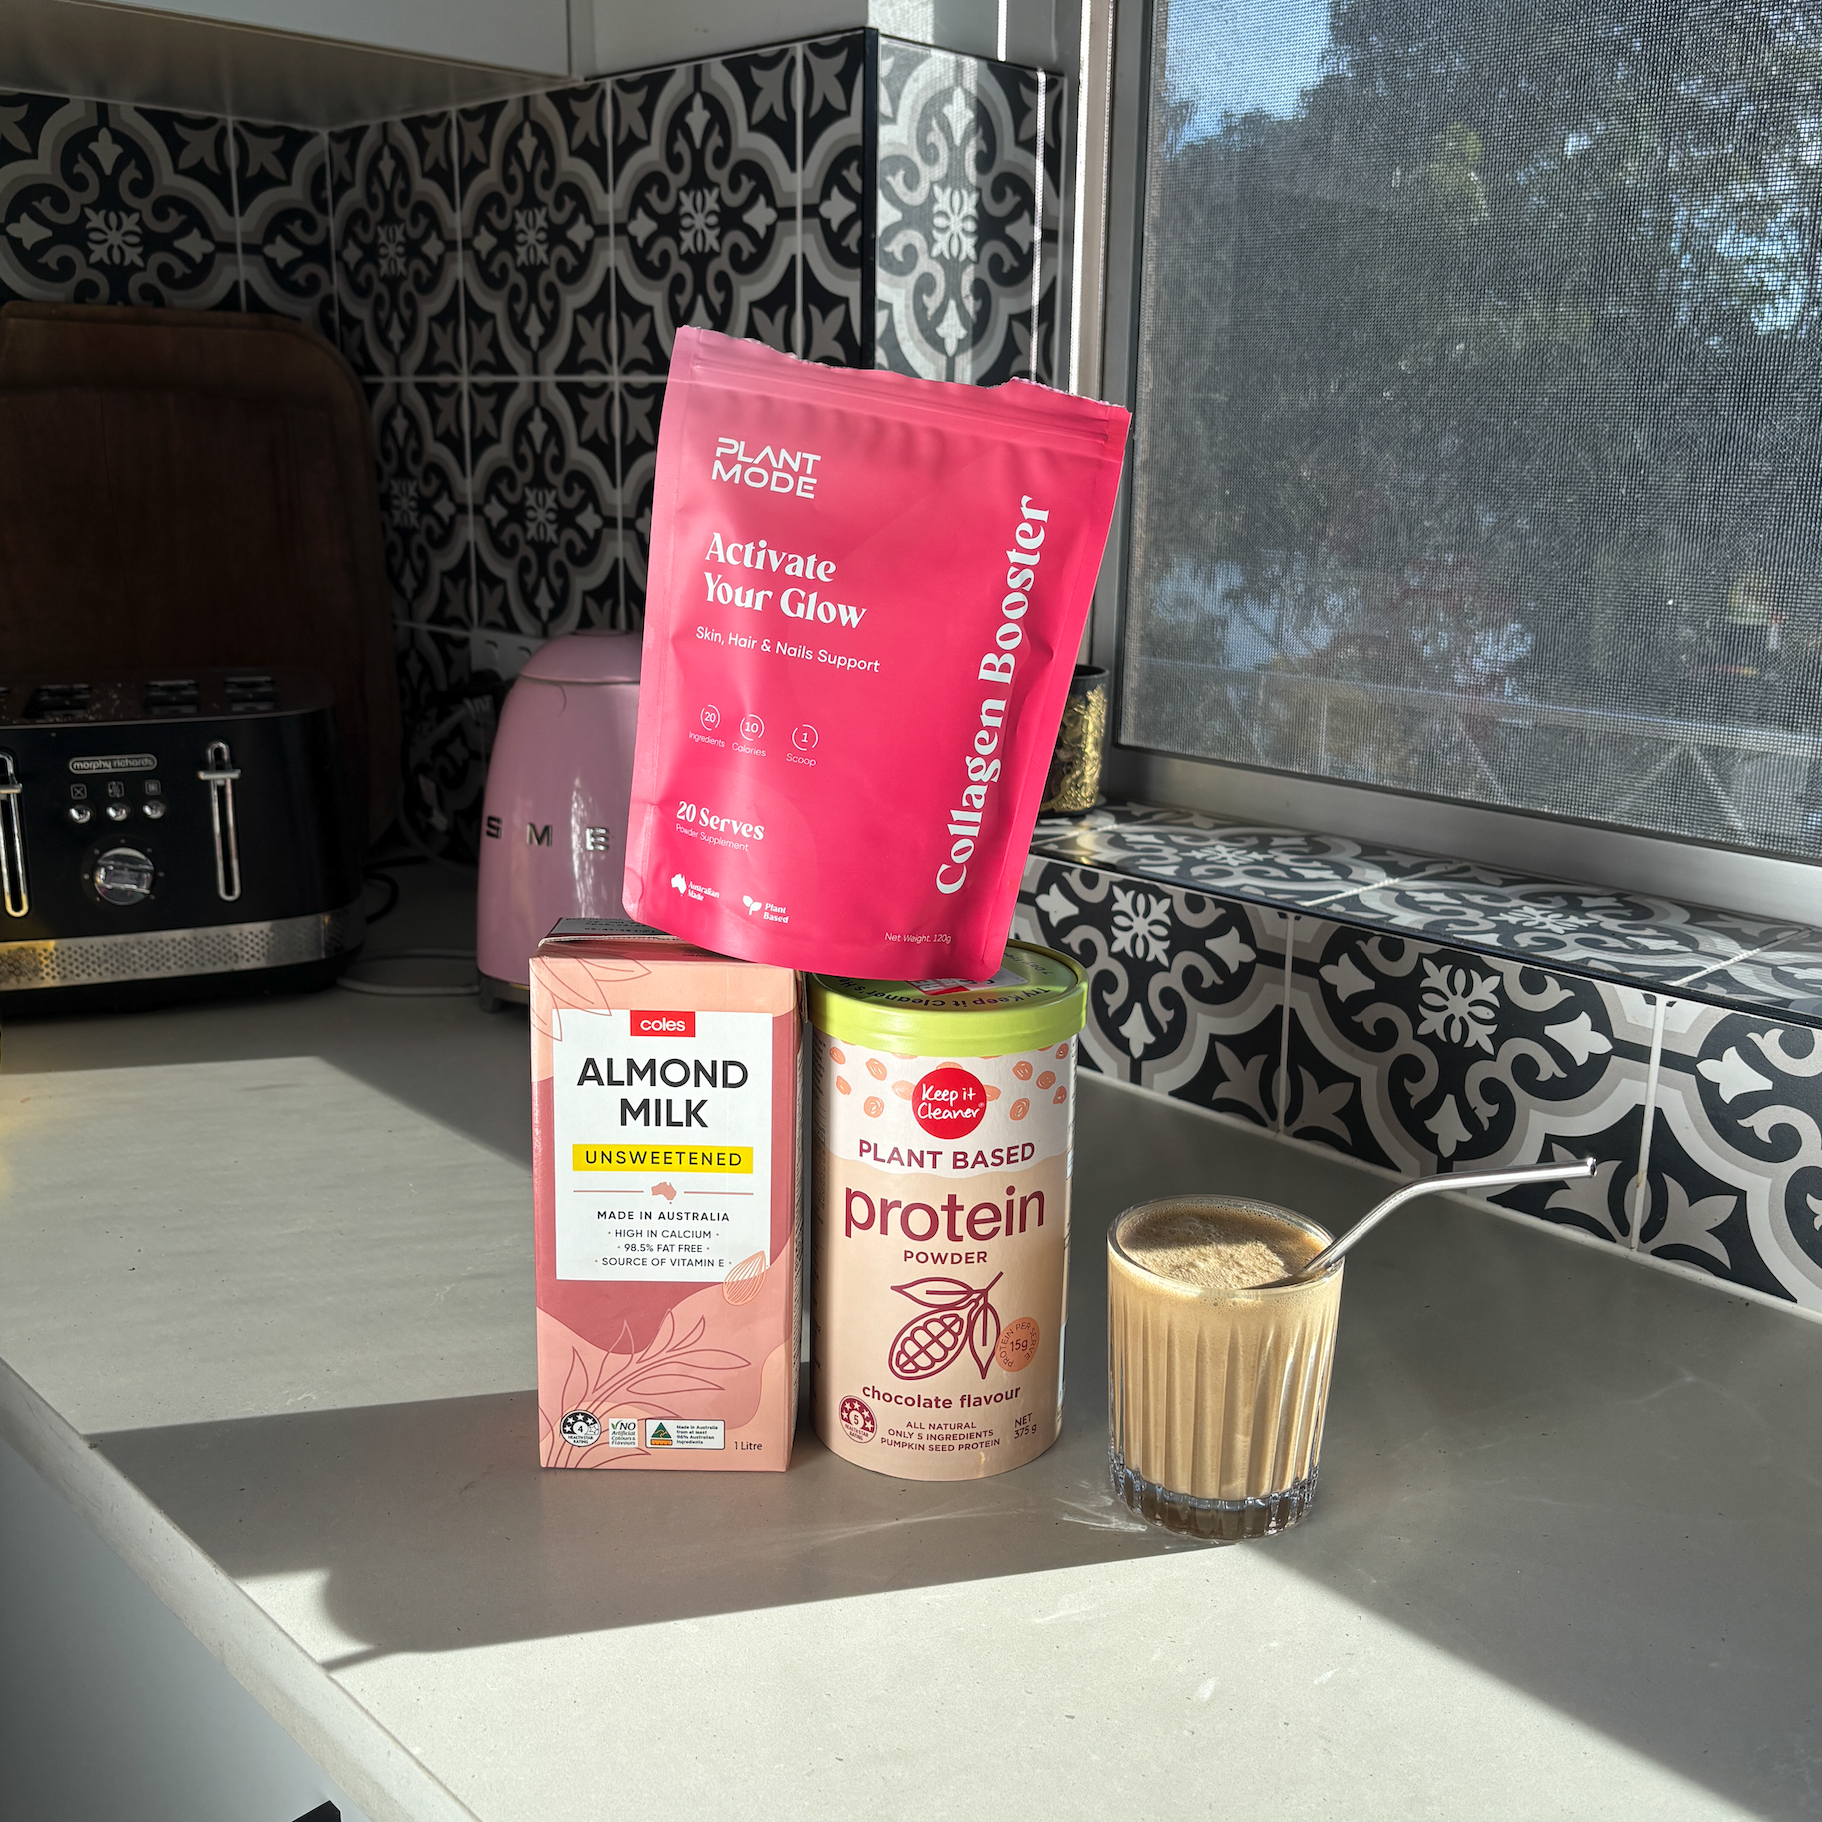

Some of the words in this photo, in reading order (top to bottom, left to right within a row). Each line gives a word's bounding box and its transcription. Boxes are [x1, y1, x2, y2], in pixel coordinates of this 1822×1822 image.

[715, 437, 821, 475] PLANT
[711, 460, 818, 499] MODE
[705, 532, 837, 583] Activate
[704, 572, 773, 611] Your
[780, 587, 867, 629] Glow
[696, 626, 725, 645] Skin,
[728, 632, 757, 649] Hair
[761, 639, 772, 653] &
[776, 641, 813, 660] Nails
[817, 650, 880, 673] Support
[936, 698, 1007, 895] Collagen
[978, 494, 1050, 685] Booster
[704, 711, 717, 723] 20
[744, 722, 759, 733] 10
[688, 731, 726, 748] Ingredients
[801, 732, 809, 743] 1
[732, 742, 767, 757] Calories
[73, 758, 112, 771] morphy
[113, 757, 154, 768] richards
[786, 753, 817, 767] Scoop
[676, 801, 697, 823] 20
[699, 807, 765, 841] Serves
[676, 823, 699, 838] Powder
[699, 831, 749, 852] Supplement
[687, 889, 704, 901] Made
[688, 880, 720, 899] Australian
[764, 902, 787, 914] Plant
[763, 912, 789, 924] Based
[884, 931, 901, 943] Net
[933, 933, 952, 944] 120g
[1024, 986, 1051, 999] Try
[952, 999, 967, 1008] it
[973, 994, 1024, 1006] Keep
[639, 1017, 686, 1032] coles
[577, 1058, 749, 1089] ALMOND
[921, 1083, 959, 1105] Keep
[961, 1087, 977, 1101] it
[620, 1098, 709, 1128] MILK
[585, 1150, 742, 1167] UNSWEETENED
[859, 1138, 943, 1169] PLANT
[952, 1142, 1035, 1170] BASED
[597, 1211, 635, 1221] MADE
[639, 1211, 653, 1221] IN
[658, 1211, 730, 1222] AUSTRALIA
[845, 1185, 1045, 1243] protein
[614, 1229, 643, 1239] HIGH
[646, 1229, 659, 1239] IN
[661, 1229, 712, 1239] CALCIUM
[624, 1243, 654, 1253] 98.5%
[657, 1244, 676, 1253] FAT
[678, 1244, 703, 1253] FREE
[602, 1257, 649, 1267] SOURCE
[651, 1258, 667, 1267] OF
[669, 1258, 716, 1267] VITAMIN
[718, 1258, 725, 1267] E
[904, 1250, 988, 1264] POWDER
[999, 1328, 1014, 1368] PROTEIN
[1015, 1321, 1031, 1331] PER
[1024, 1327, 1037, 1361] SERVE
[1009, 1339, 1028, 1352] 15g
[862, 1385, 953, 1409] chocolate
[959, 1385, 1021, 1408] flavour
[619, 1422, 636, 1431] NO
[853, 1414, 859, 1425] 5
[906, 1421, 926, 1430] ALL
[928, 1421, 977, 1430] NATURAL
[1014, 1412, 1033, 1428] NET
[577, 1425, 584, 1433] 4
[888, 1428, 915, 1439] ONLY
[926, 1429, 994, 1441] INGREDIENTS
[1014, 1427, 1030, 1439] 375
[740, 1441, 763, 1450] Litre
[881, 1438, 926, 1451] PUMPKIN
[958, 1438, 1001, 1451] PROTEIN
